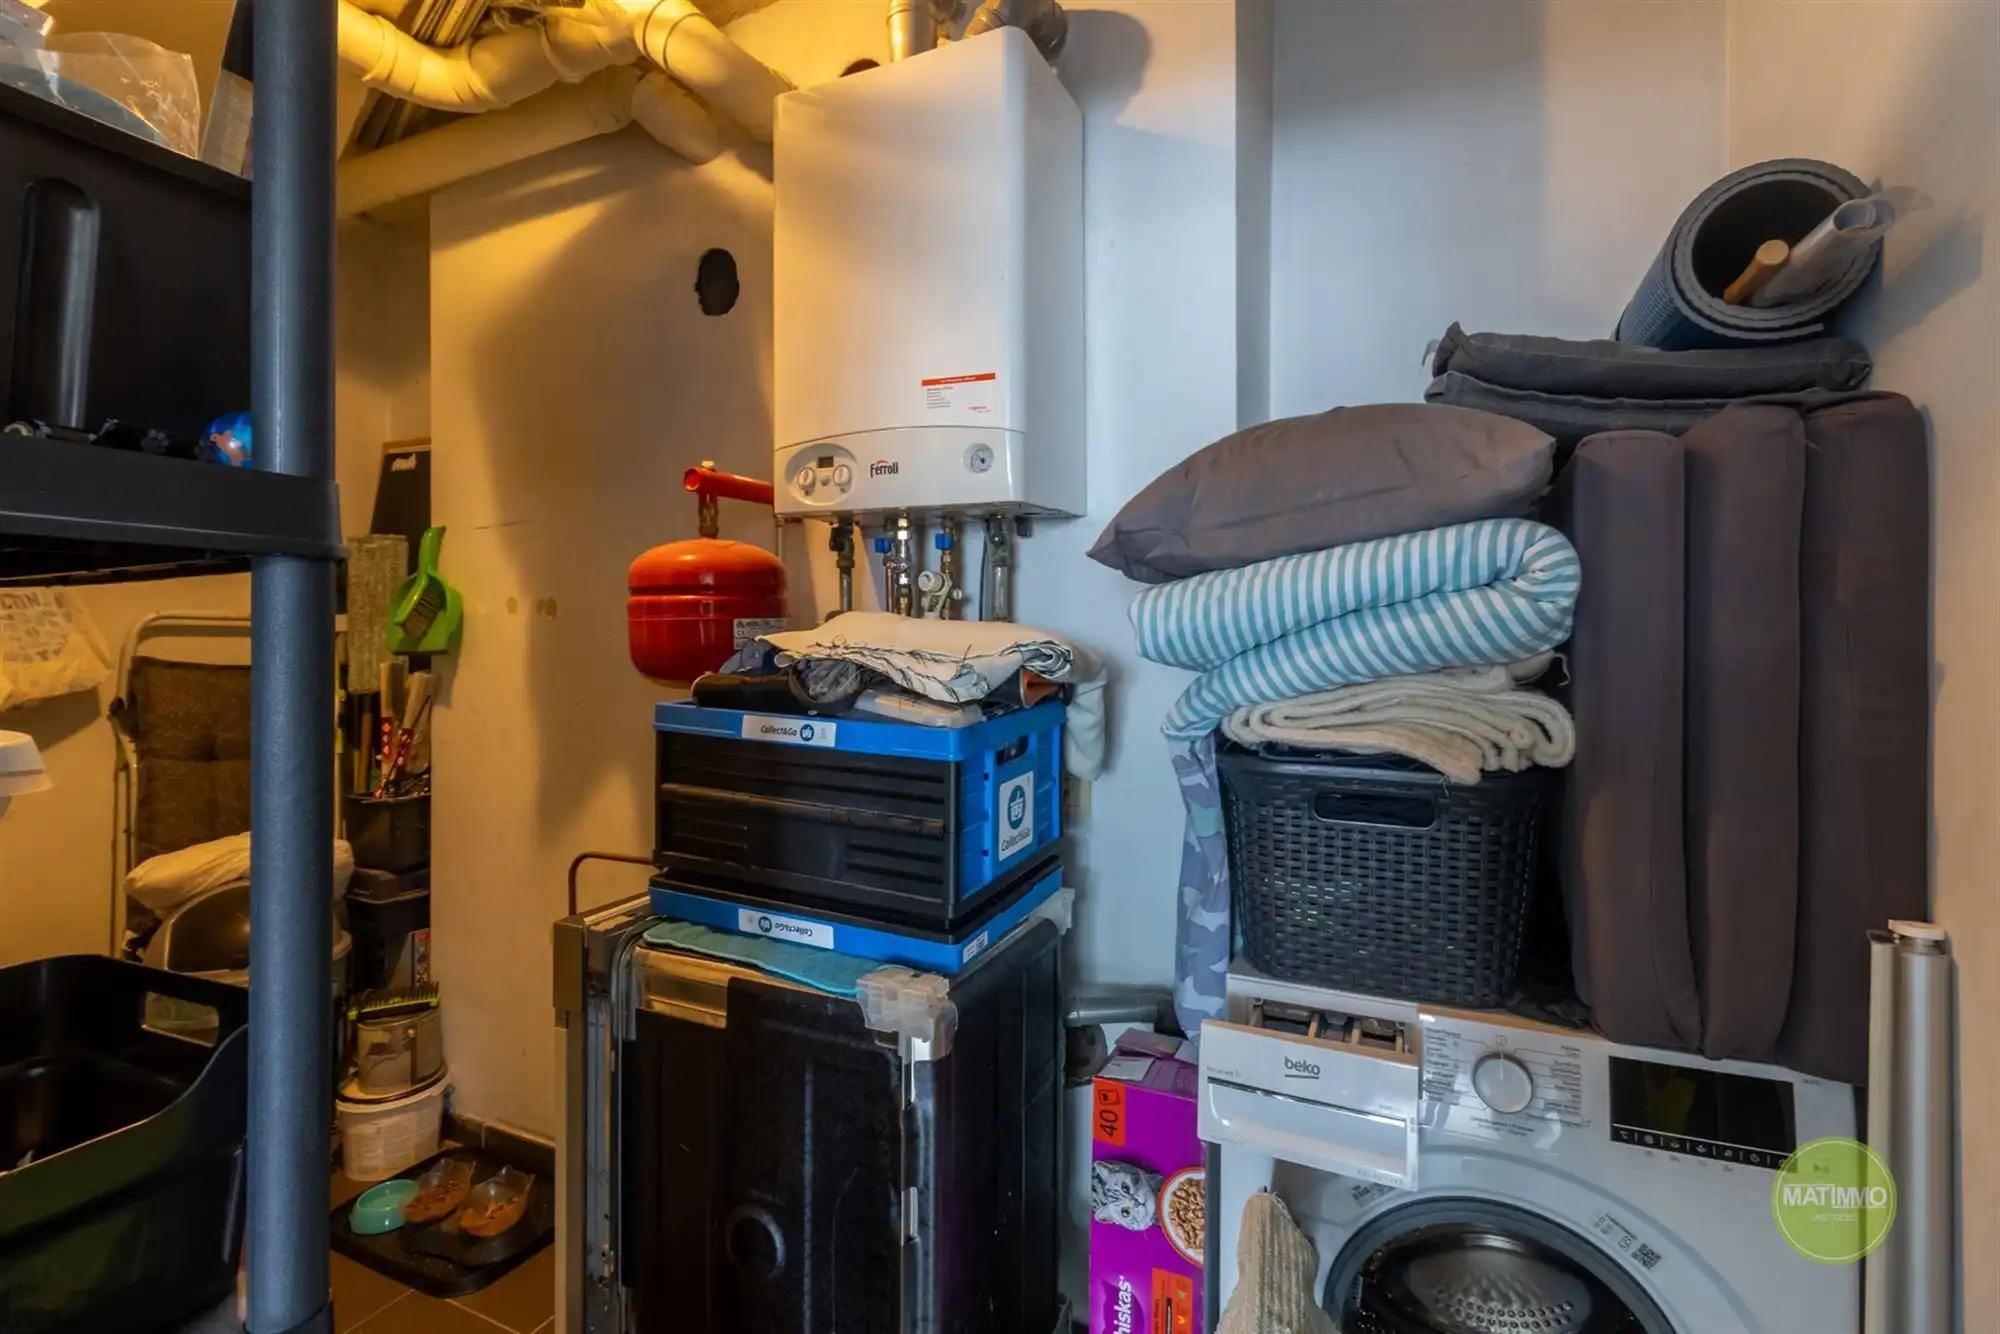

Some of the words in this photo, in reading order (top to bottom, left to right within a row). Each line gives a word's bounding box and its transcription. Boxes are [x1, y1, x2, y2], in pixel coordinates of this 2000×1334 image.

[870, 461, 899, 478] Ferroli
[760, 724, 798, 737] Collect&Go
[1001, 828, 1031, 852] Collect&Go
[773, 922, 814, 938] Collect&Go
[1284, 1056, 1321, 1076] beko
[1099, 1109, 1119, 1138] 40
[1113, 1279, 1132, 1334] hiskas
